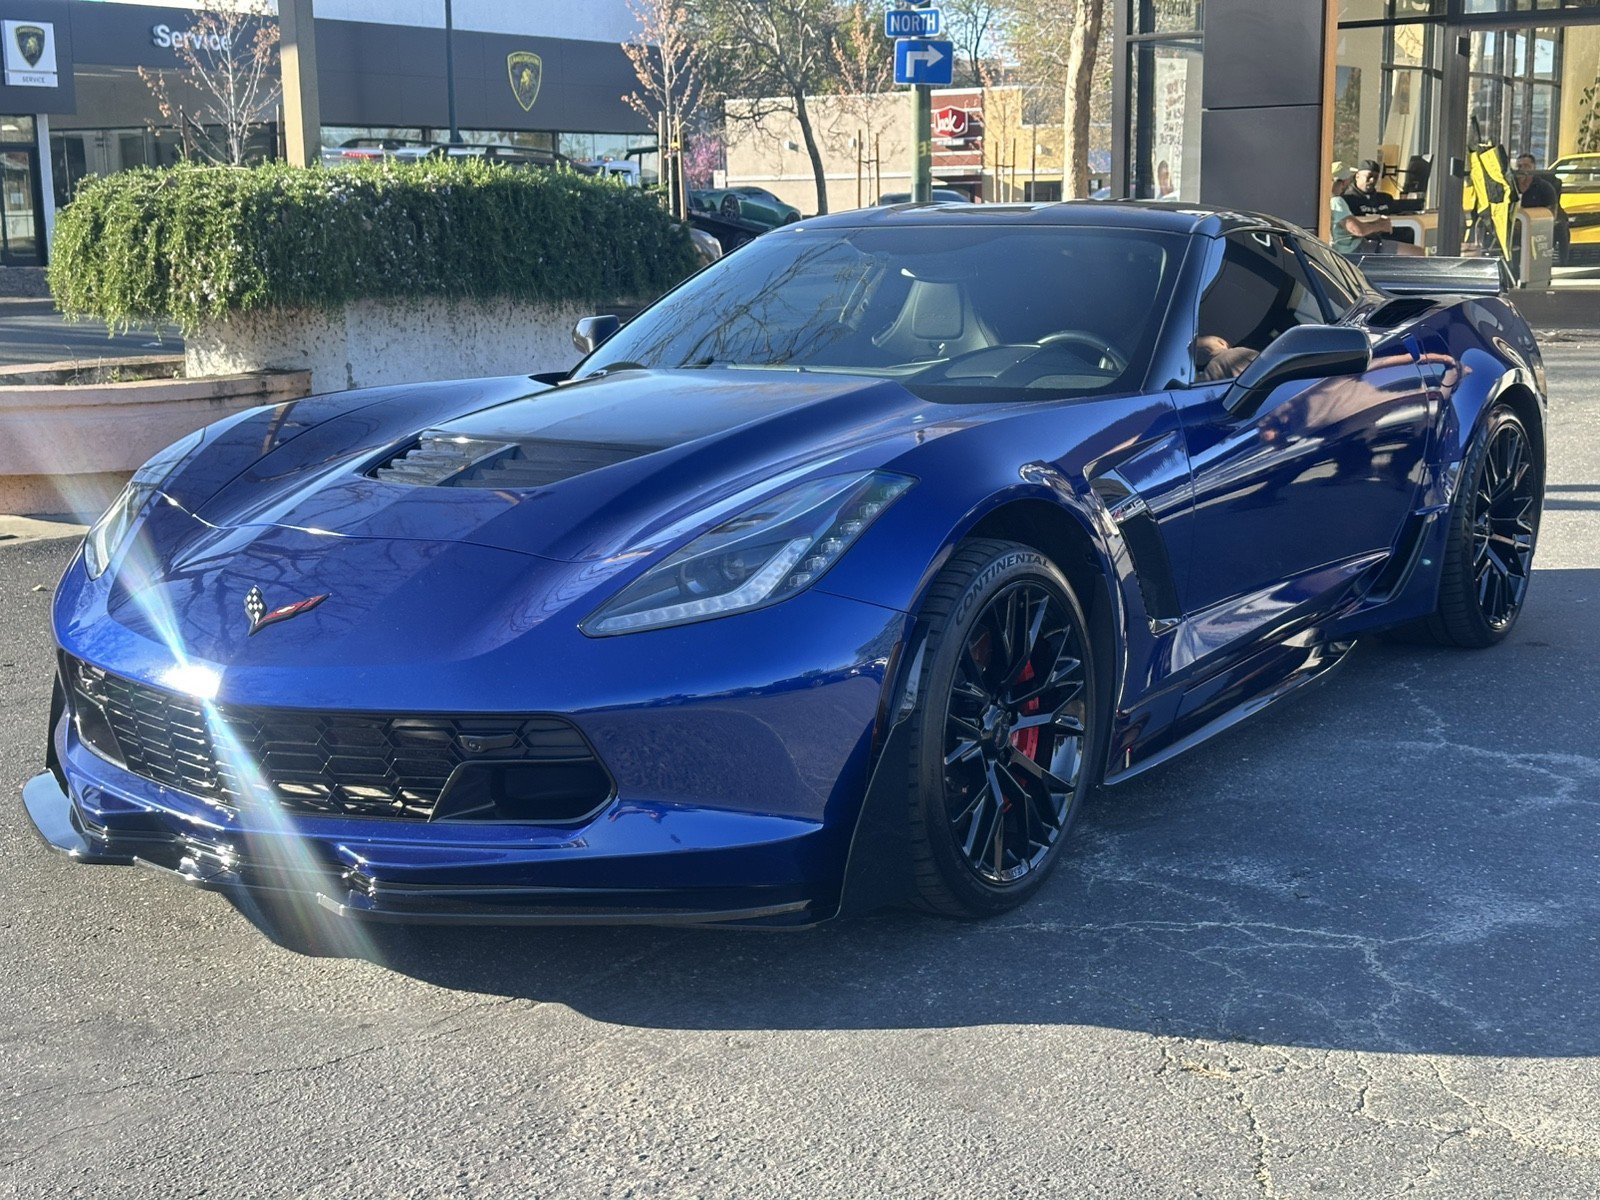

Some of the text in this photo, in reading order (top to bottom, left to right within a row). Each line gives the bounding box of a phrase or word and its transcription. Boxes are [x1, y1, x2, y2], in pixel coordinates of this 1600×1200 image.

[890, 13, 936, 32] NORTH
[153, 24, 231, 51] Service
[22, 76, 46, 84] SERVICE
[935, 112, 965, 134] Jack
[956, 552, 1050, 627] CONTINENTAL
